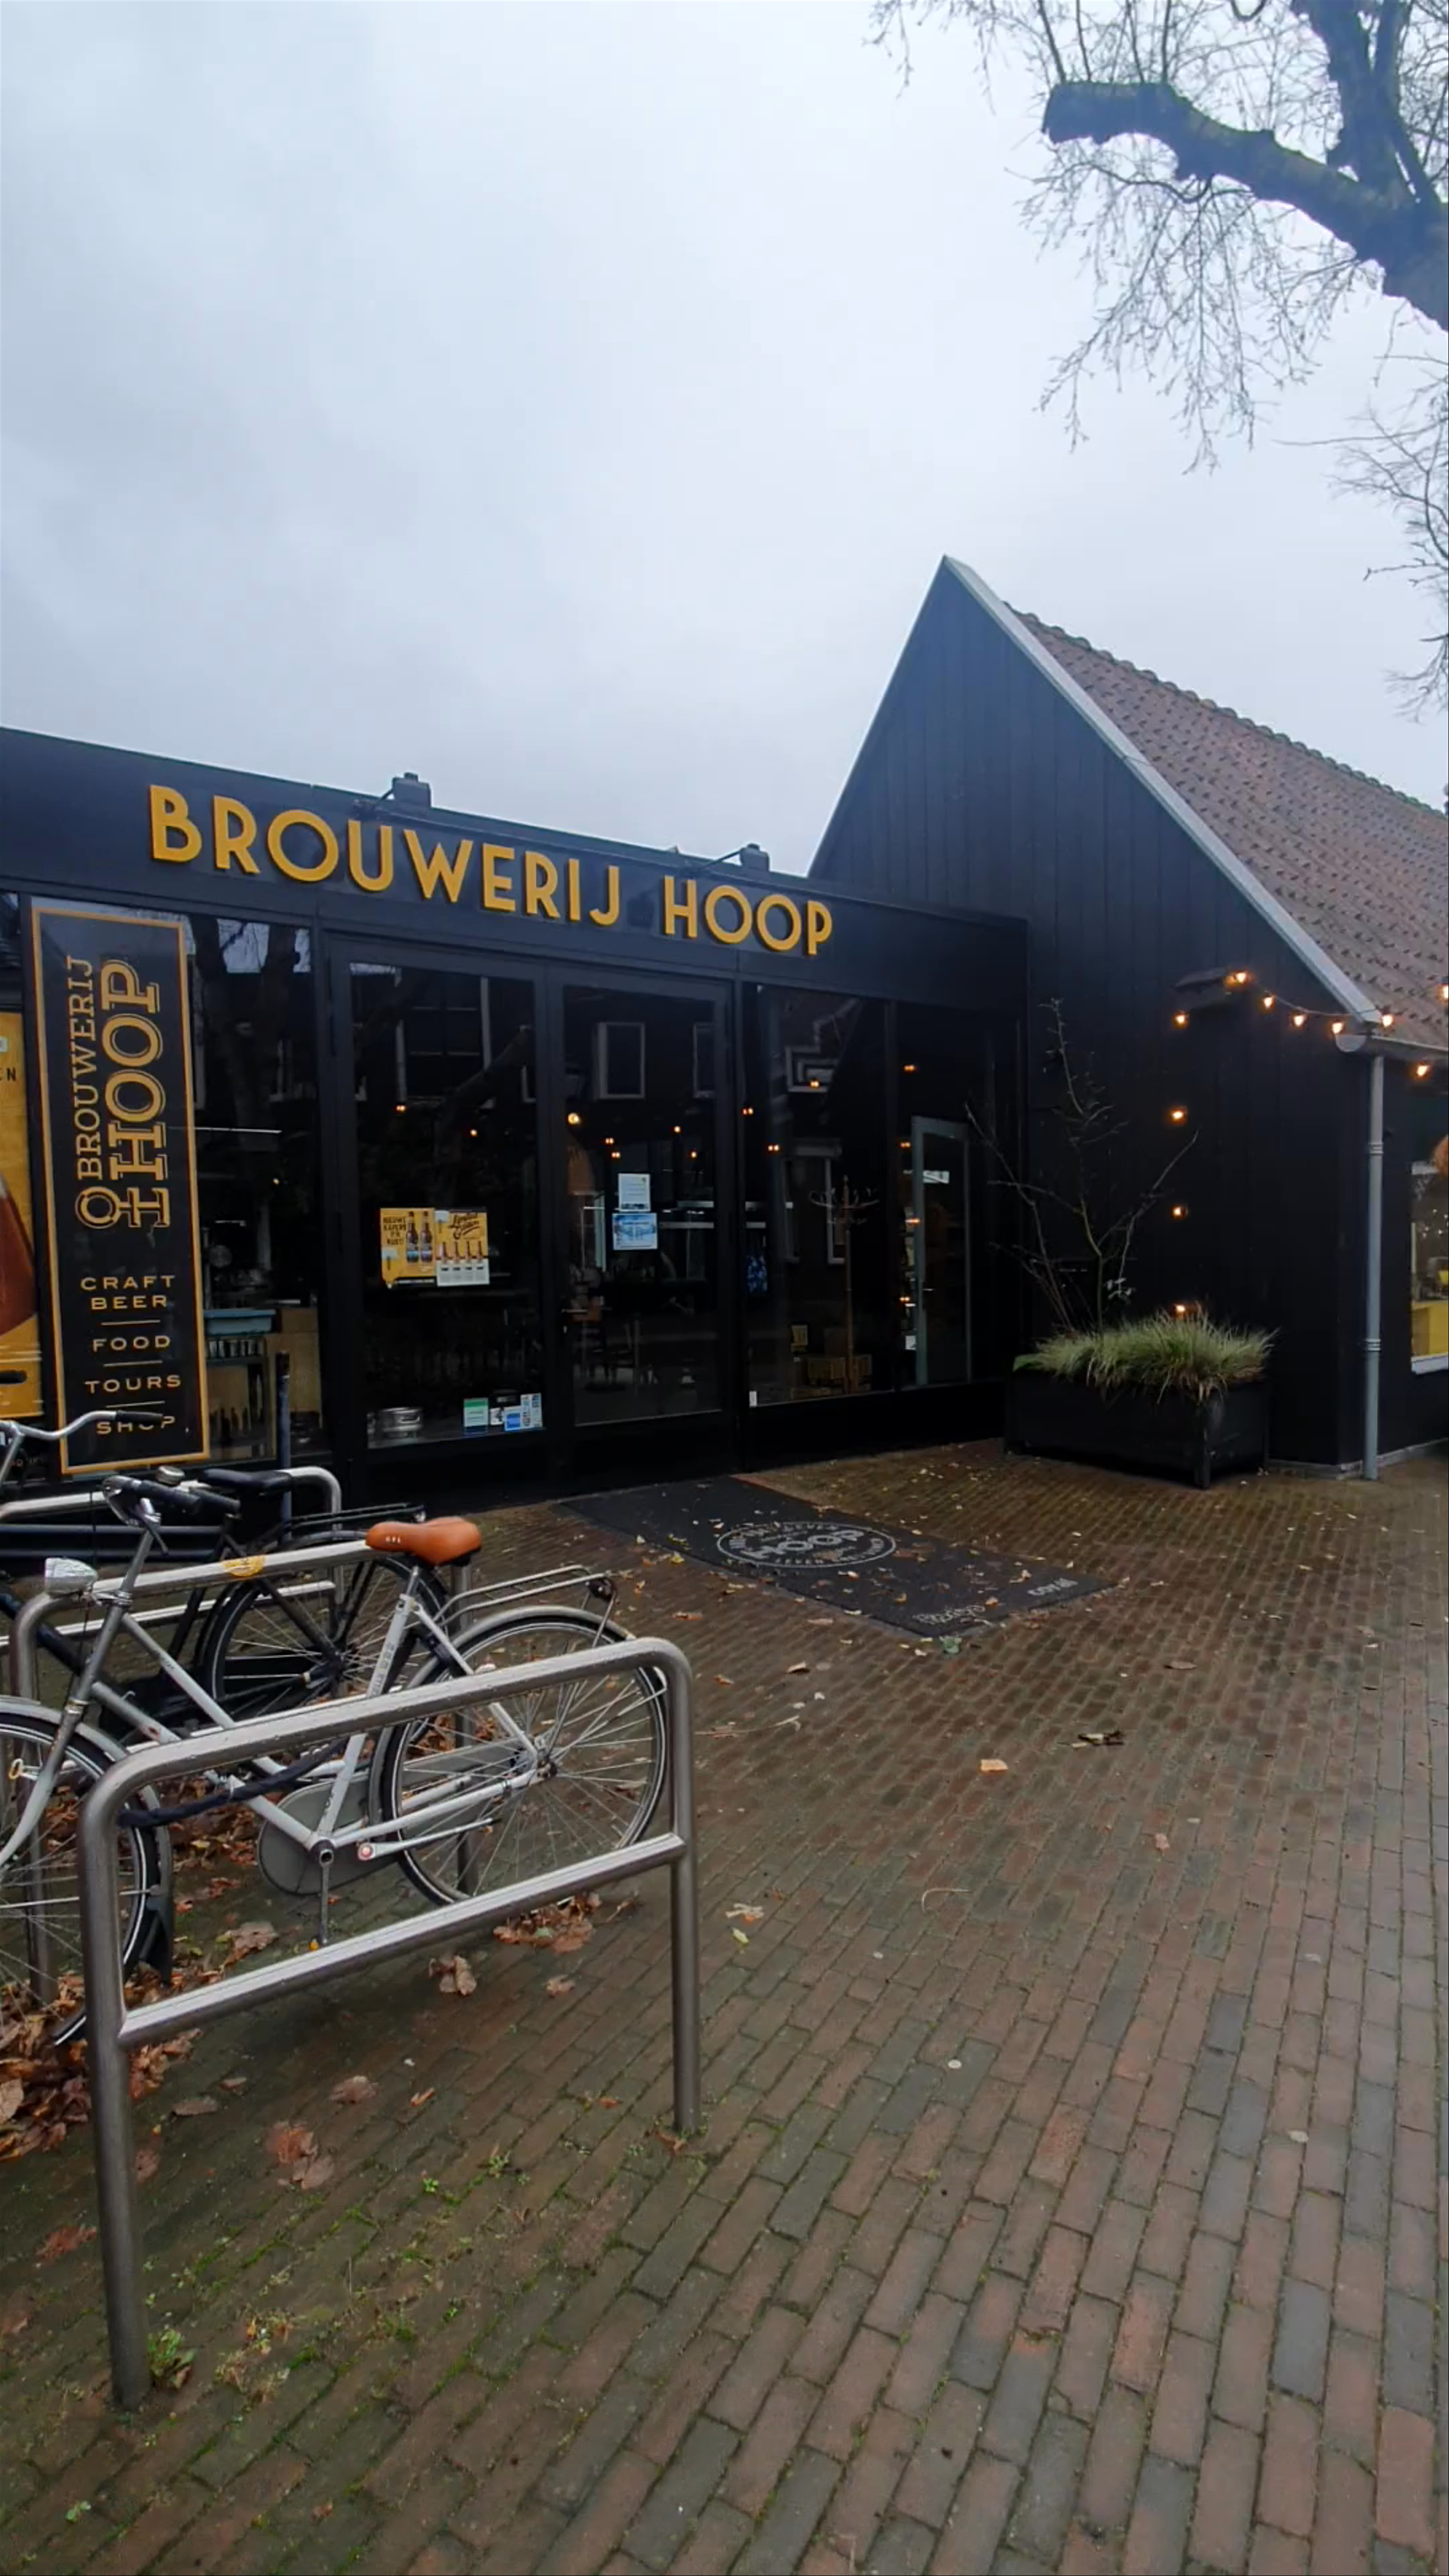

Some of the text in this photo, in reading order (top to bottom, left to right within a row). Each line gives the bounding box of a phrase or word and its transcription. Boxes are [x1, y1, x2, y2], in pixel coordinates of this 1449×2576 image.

[149, 785, 832, 956] BROUWERIJ HOOP
[0, 1067, 16, 1081] N
[66, 955, 102, 1181] BROUWERIJ
[100, 960, 169, 1181] HOOP
[80, 1275, 175, 1290] CRAFT
[91, 1295, 167, 1310] BEER
[93, 1335, 171, 1352] FOOD
[85, 1375, 181, 1394] TOURS
